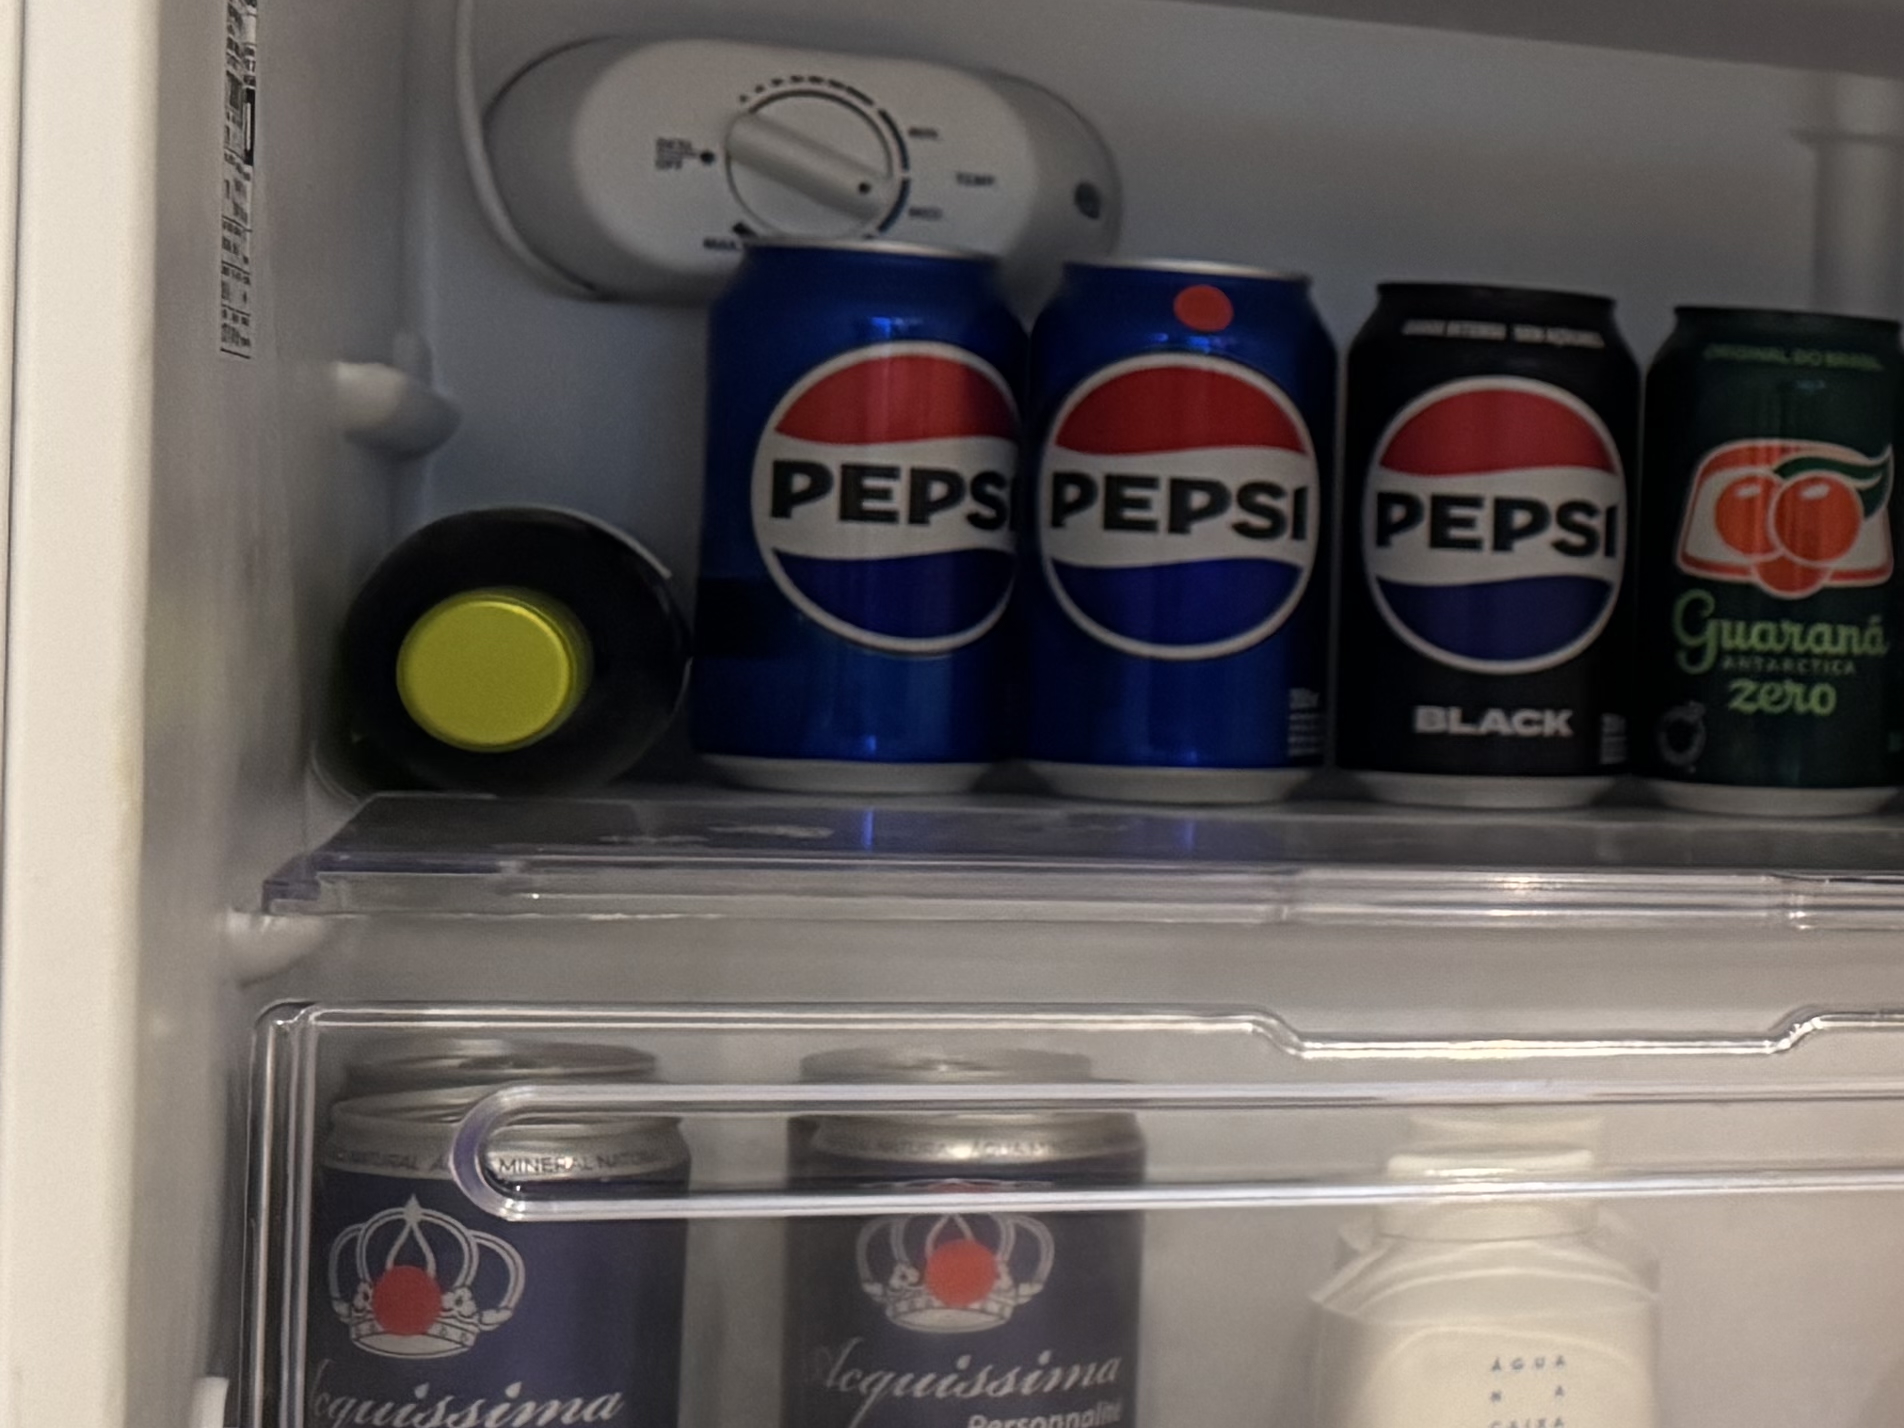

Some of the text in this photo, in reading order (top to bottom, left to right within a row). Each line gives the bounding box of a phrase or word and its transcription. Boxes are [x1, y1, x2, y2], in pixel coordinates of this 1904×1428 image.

[1050, 470, 1308, 542] PEPSI
[1376, 491, 1618, 559] PEPSI
[1674, 589, 1888, 674] Guaraná
[1414, 704, 1575, 738] BLACK
[1728, 677, 1837, 716] zero
